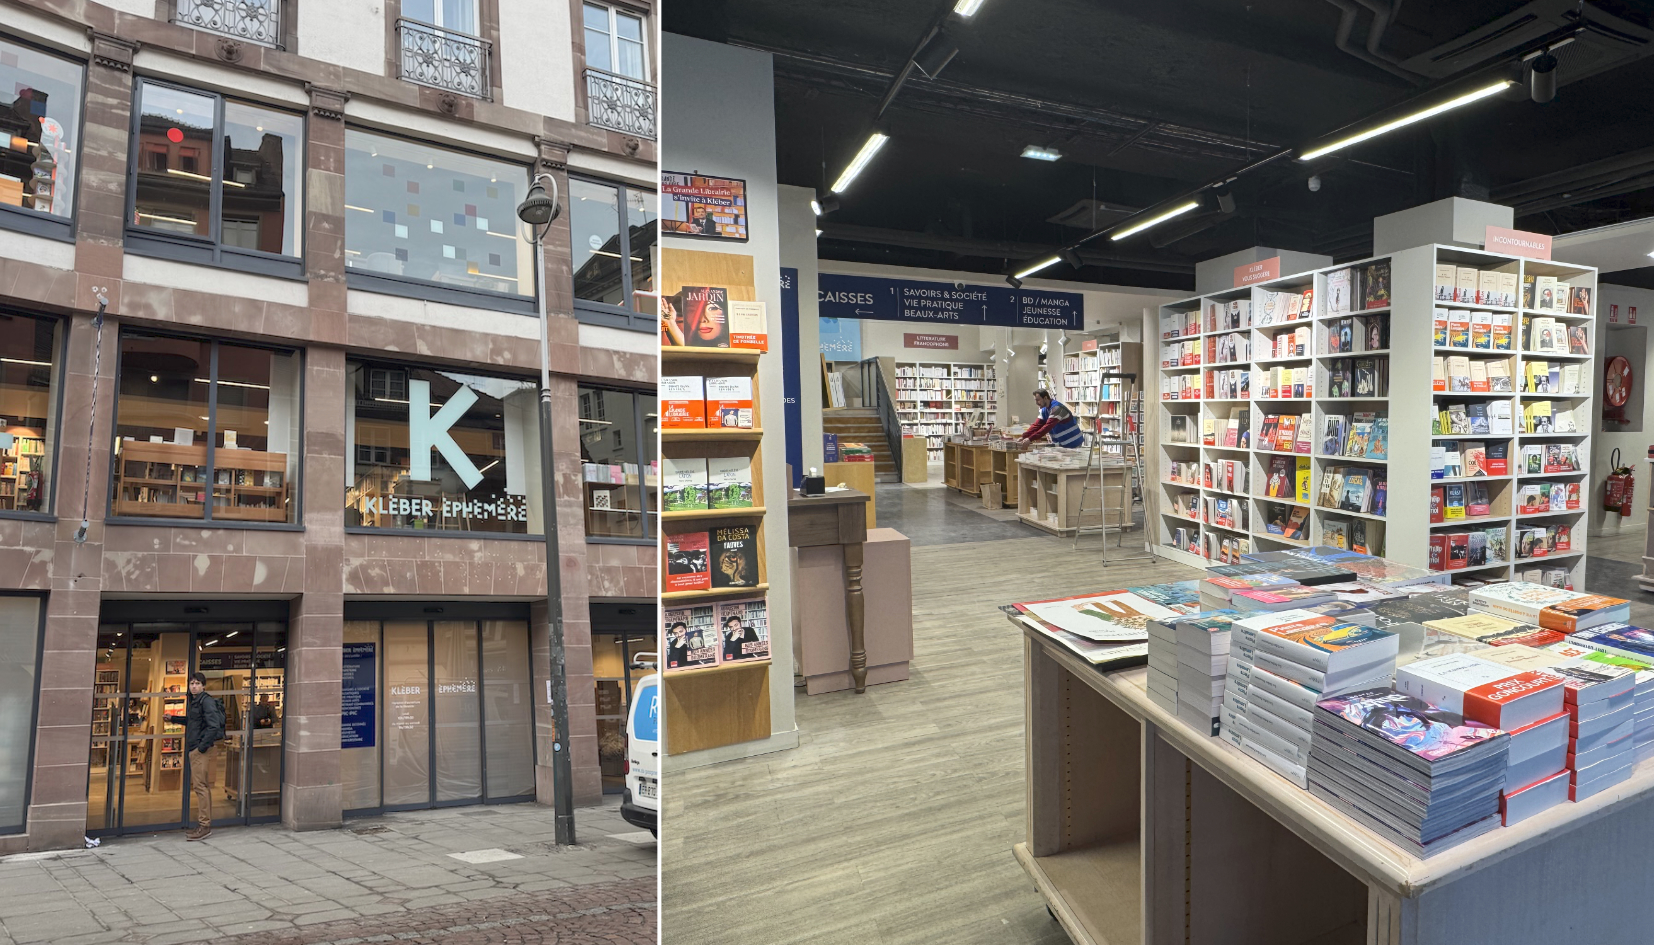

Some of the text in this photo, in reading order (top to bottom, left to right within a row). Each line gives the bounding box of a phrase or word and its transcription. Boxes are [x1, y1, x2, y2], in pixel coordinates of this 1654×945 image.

[707, 198, 730, 206] Kléber
[1493, 236, 1545, 250] INCONTOURNABLES
[686, 292, 724, 302] JARDIN
[818, 290, 873, 305] CAISSES
[904, 288, 941, 298] SAVOIRS
[952, 291, 987, 301] SOCIÉTÉ
[920, 300, 964, 310] PRATIQUE
[1041, 298, 1070, 306] MANGA
[904, 310, 959, 319] BEAUX-ARTS
[1023, 307, 1061, 316] JEUNESSE
[1023, 315, 1068, 326] ÉDUCATION
[409, 379, 484, 490] K
[1269, 623, 1303, 633] Pierre
[1488, 674, 1557, 700] GONCOURT
[1493, 679, 1525, 690] PRIX
